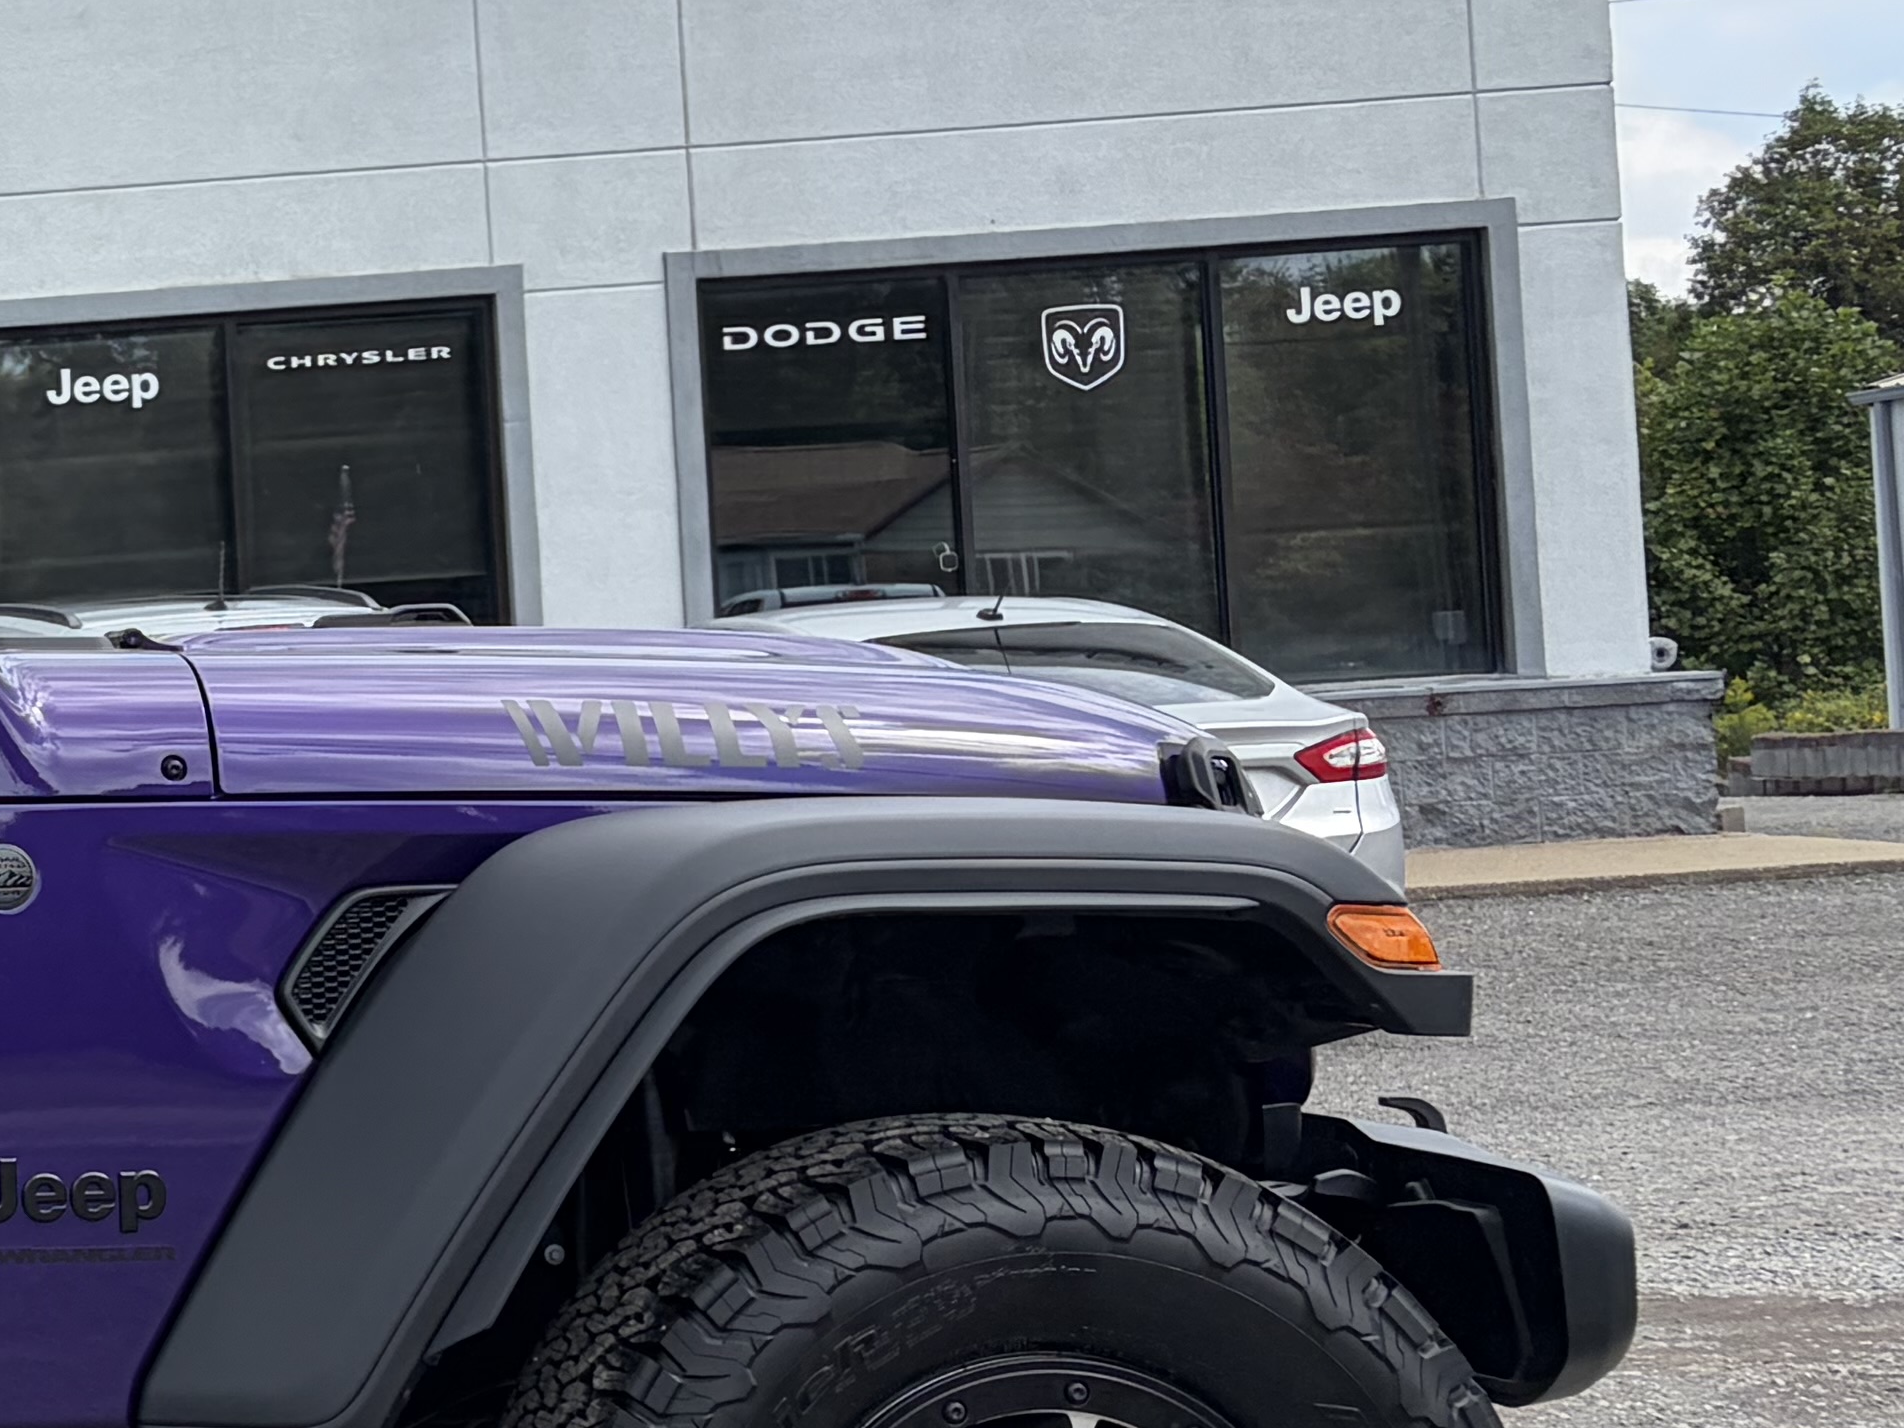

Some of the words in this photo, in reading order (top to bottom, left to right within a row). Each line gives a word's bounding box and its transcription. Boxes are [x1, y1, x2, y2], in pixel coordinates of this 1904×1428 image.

[1286, 286, 1402, 326] Jeep
[722, 315, 927, 351] DODGE
[266, 345, 452, 371] CHRYSLER
[46, 369, 159, 408] Jeep
[501, 700, 866, 770] WILLYS
